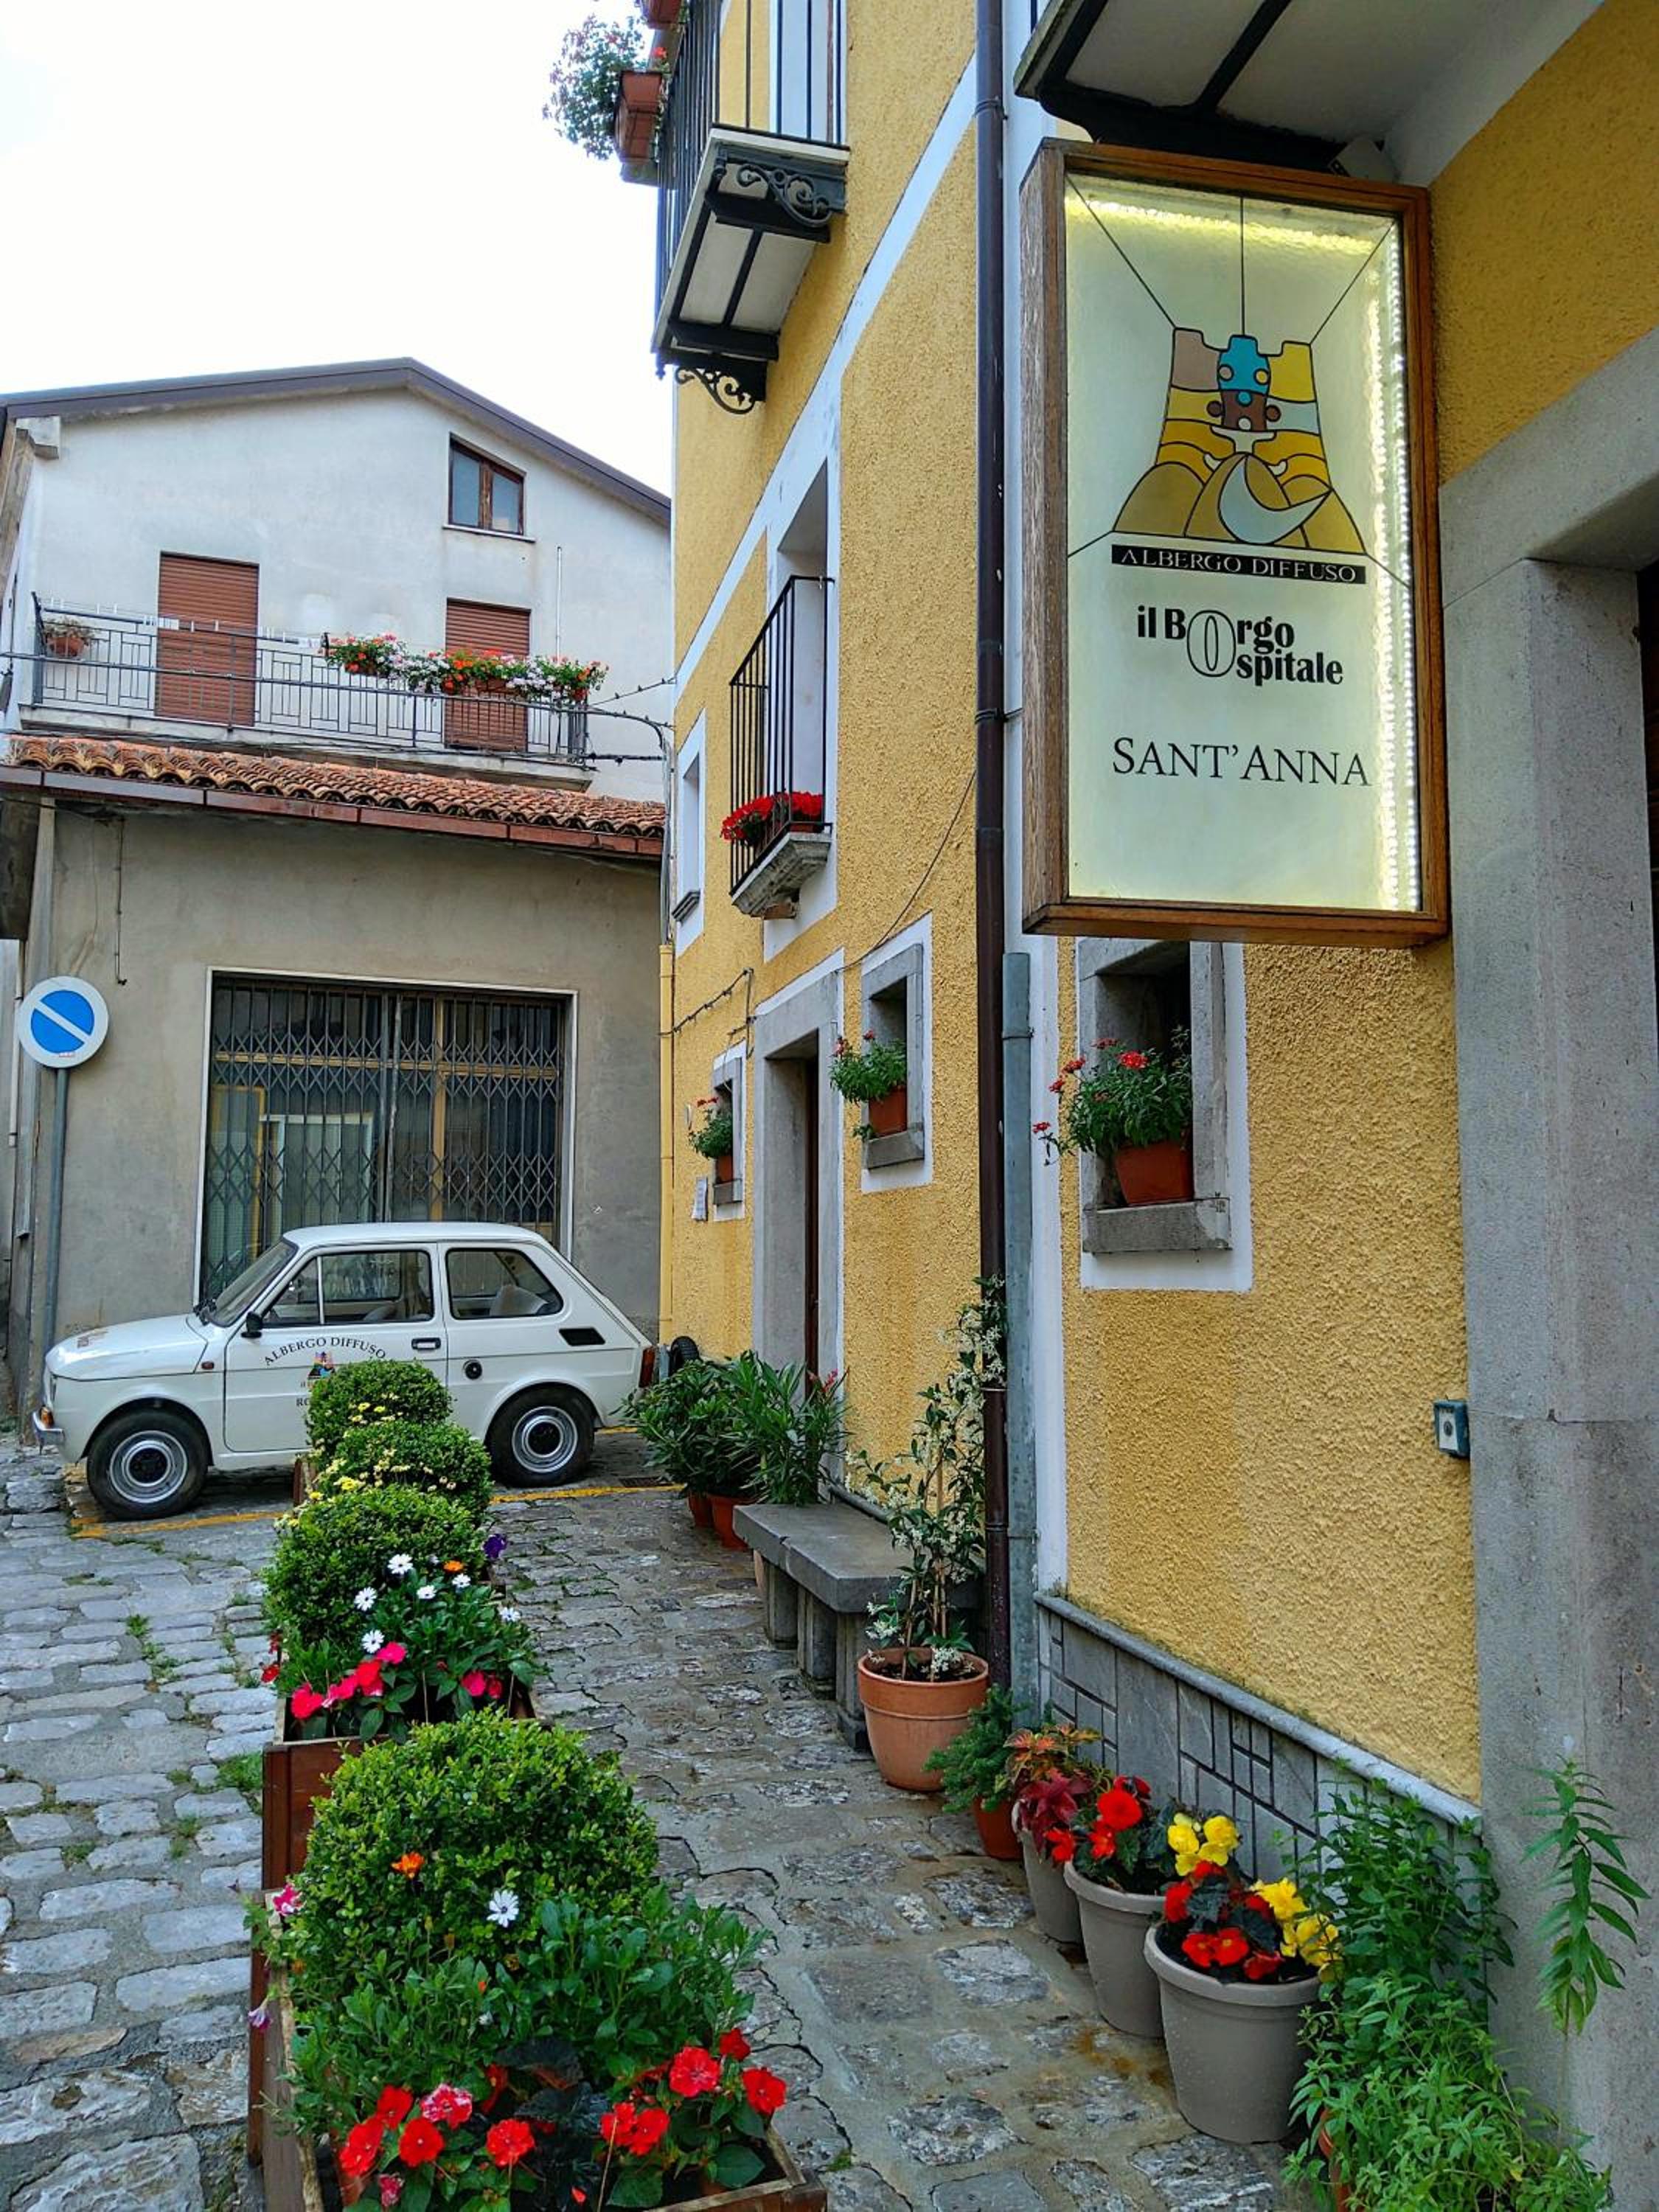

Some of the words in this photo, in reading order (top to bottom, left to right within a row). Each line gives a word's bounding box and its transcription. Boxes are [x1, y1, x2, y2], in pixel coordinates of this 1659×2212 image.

[1121, 549, 1242, 573] ALBERGO
[1253, 558, 1356, 582] DIFFUSO
[1138, 605, 1157, 639] il
[264, 1337, 327, 1365] ALBERGO
[331, 1337, 386, 1359] DIFFUSO
